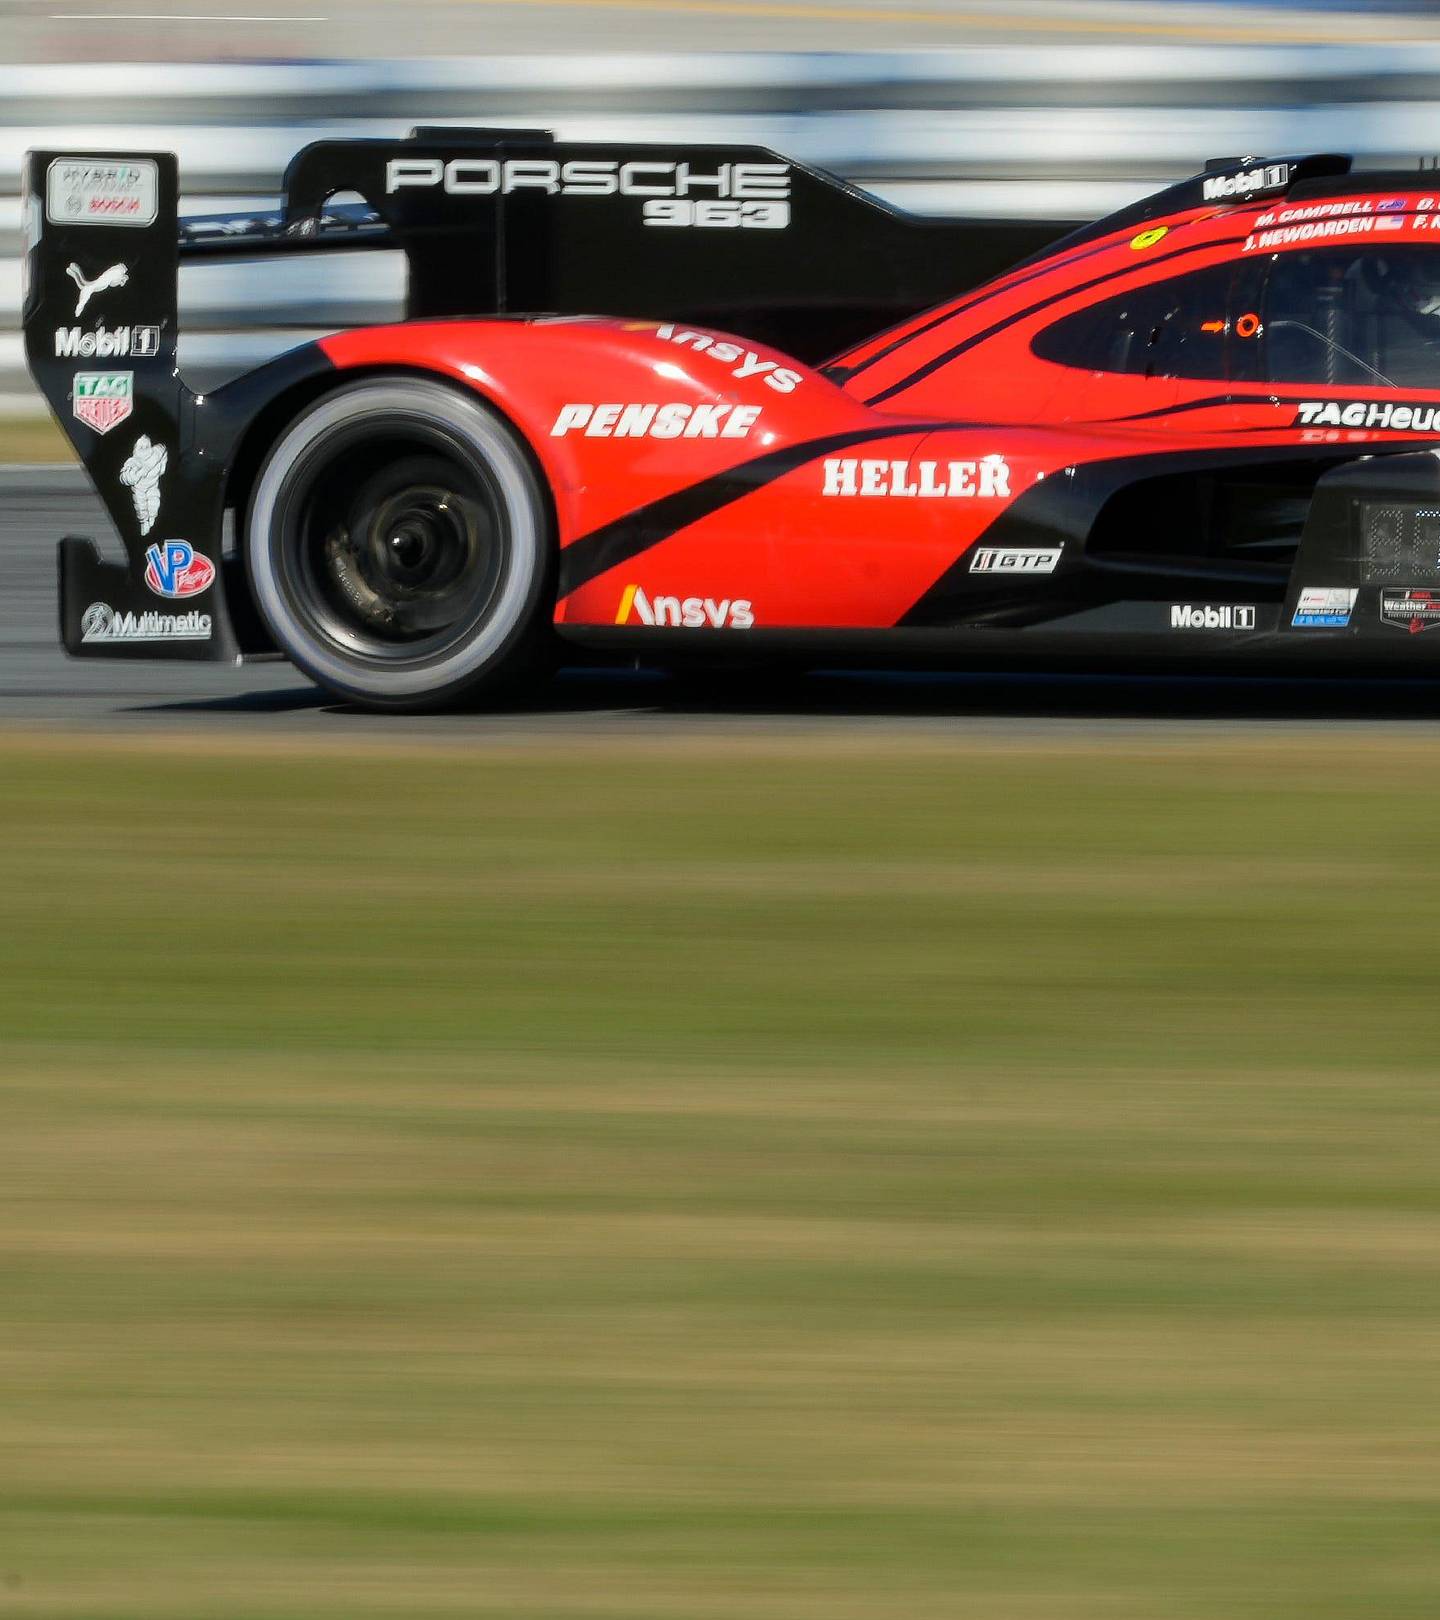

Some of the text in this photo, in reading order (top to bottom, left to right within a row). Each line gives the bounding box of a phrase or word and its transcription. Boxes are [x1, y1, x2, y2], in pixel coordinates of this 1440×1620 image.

[386, 158, 791, 198] PORSCHE
[1203, 168, 1265, 200] Mobil
[642, 199, 791, 229] 963
[54, 326, 130, 357] Mobil
[550, 404, 763, 438] PENSKE
[822, 458, 1011, 497] HELLER
[146, 541, 193, 594] VP
[999, 553, 1053, 568] GTP
[112, 610, 212, 635] Multimatic
[615, 584, 755, 629] Ansys
[1171, 605, 1231, 629] Mobil
